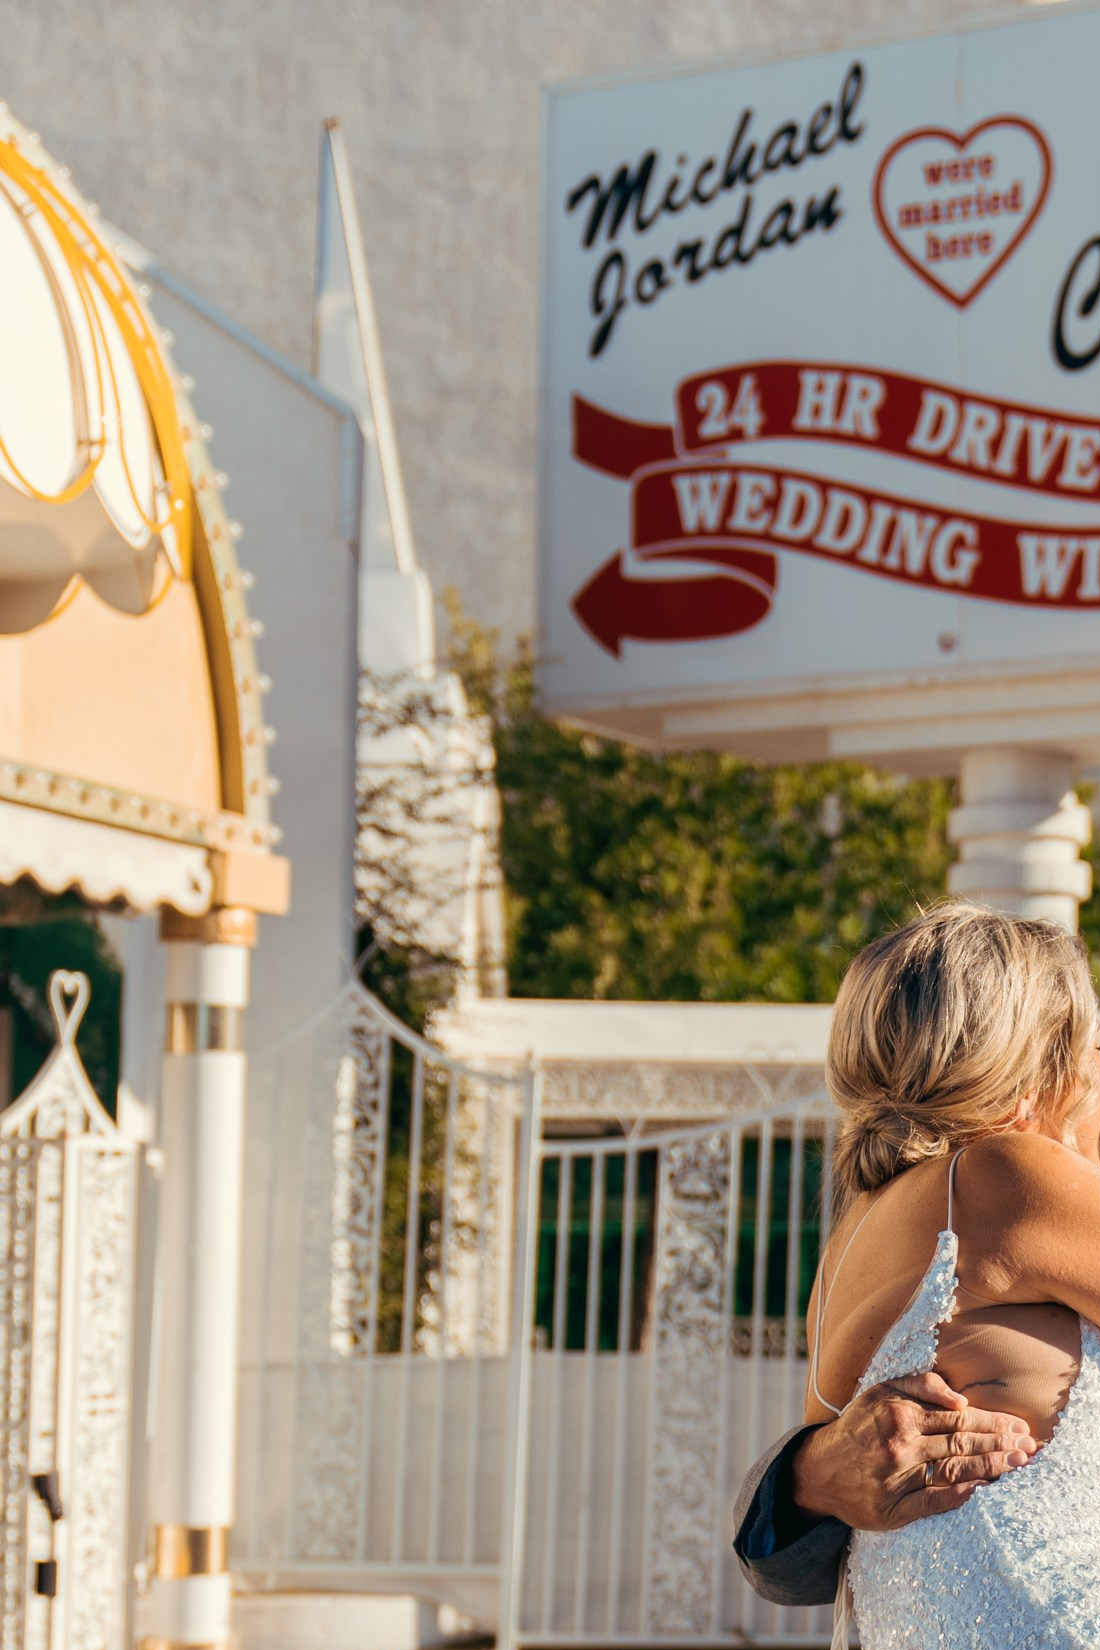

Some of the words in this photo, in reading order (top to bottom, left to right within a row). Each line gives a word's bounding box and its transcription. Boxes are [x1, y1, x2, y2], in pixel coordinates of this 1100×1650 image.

[566, 61, 865, 249] Michael
[924, 154, 995, 187] were
[899, 180, 1022, 229] married
[588, 183, 844, 361] Jordan
[925, 230, 995, 263] here
[696, 372, 765, 440] 24
[792, 367, 887, 440] HR
[671, 470, 981, 588] WEDDING
